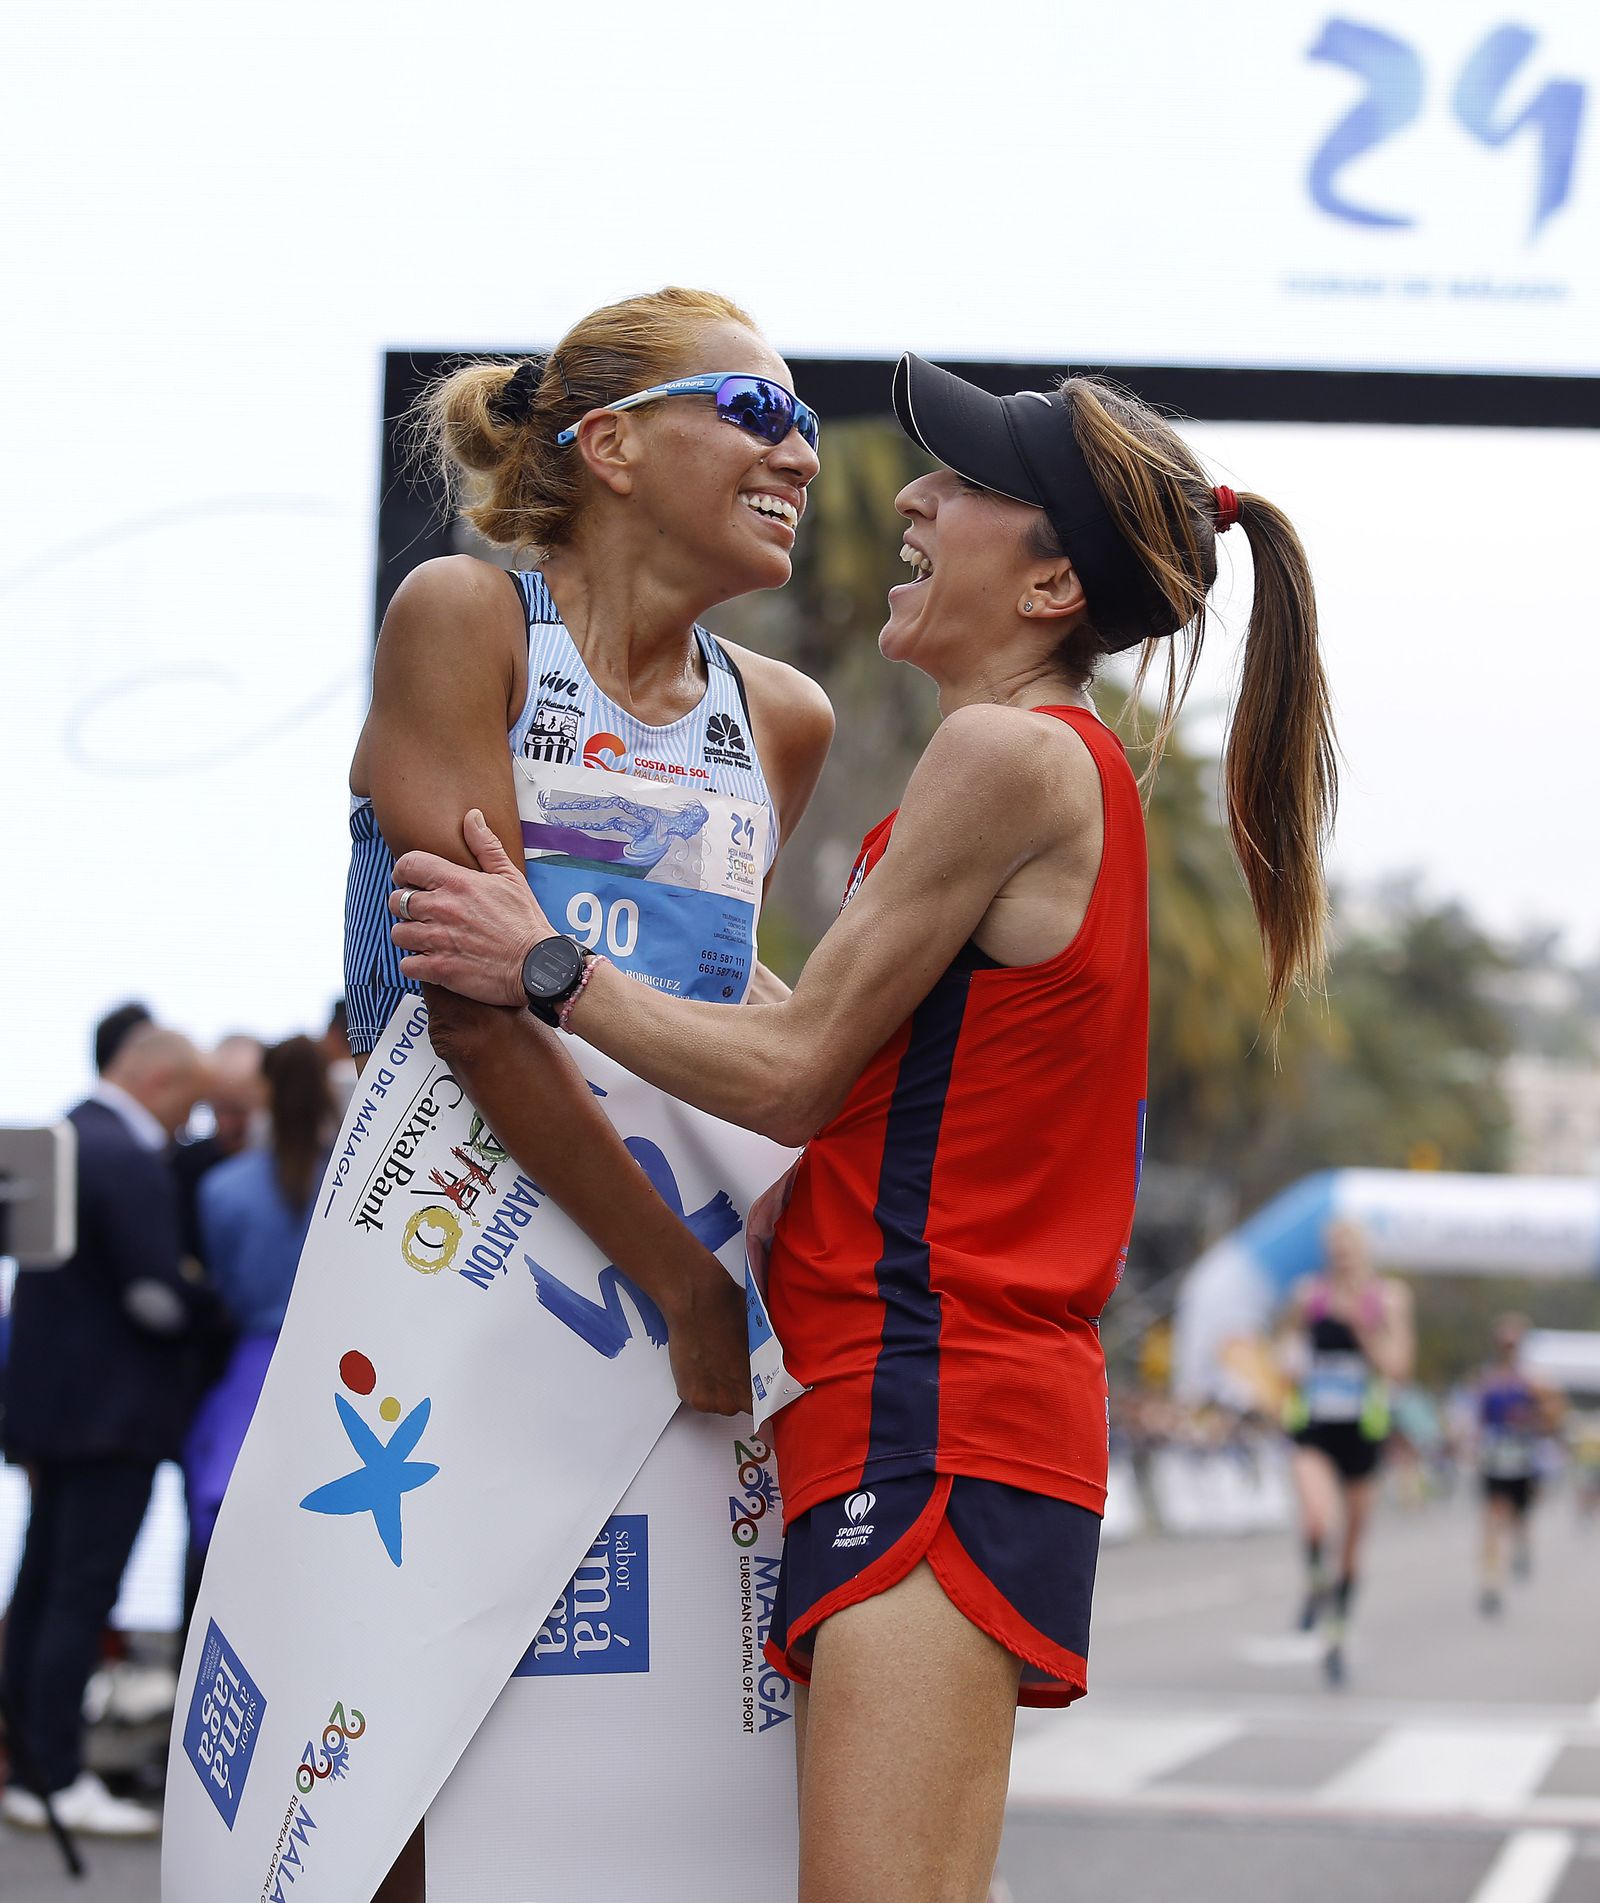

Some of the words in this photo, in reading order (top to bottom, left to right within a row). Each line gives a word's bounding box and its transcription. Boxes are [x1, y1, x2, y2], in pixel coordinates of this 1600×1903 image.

[532, 736, 570, 747] CAM
[634, 757, 666, 773] COSTA
[668, 764, 688, 776] DEL
[689, 767, 710, 779] SOL
[566, 892, 639, 957] 90
[625, 969, 681, 991] RODRIGUEZ
[698, 963, 715, 975] 663
[716, 966, 731, 977] 587
[701, 949, 718, 961] 663
[719, 953, 734, 965] 587
[735, 957, 745, 967] 111
[369, 1067, 396, 1099] DE
[332, 1099, 378, 1188] MÁLAGA
[354, 1073, 464, 1234] CaixaBank
[615, 1530, 637, 1591] sabor
[739, 1555, 752, 1622] EUROPEAN
[741, 1624, 753, 1673] CAPITAL
[742, 1675, 754, 1694] OF
[240, 1698, 257, 1754] sabor
[743, 1697, 754, 1733] SPORT
[296, 1700, 366, 1794] 2020
[275, 1794, 299, 1853] EUROPEAN
[263, 1853, 280, 1893] CAPITAL
